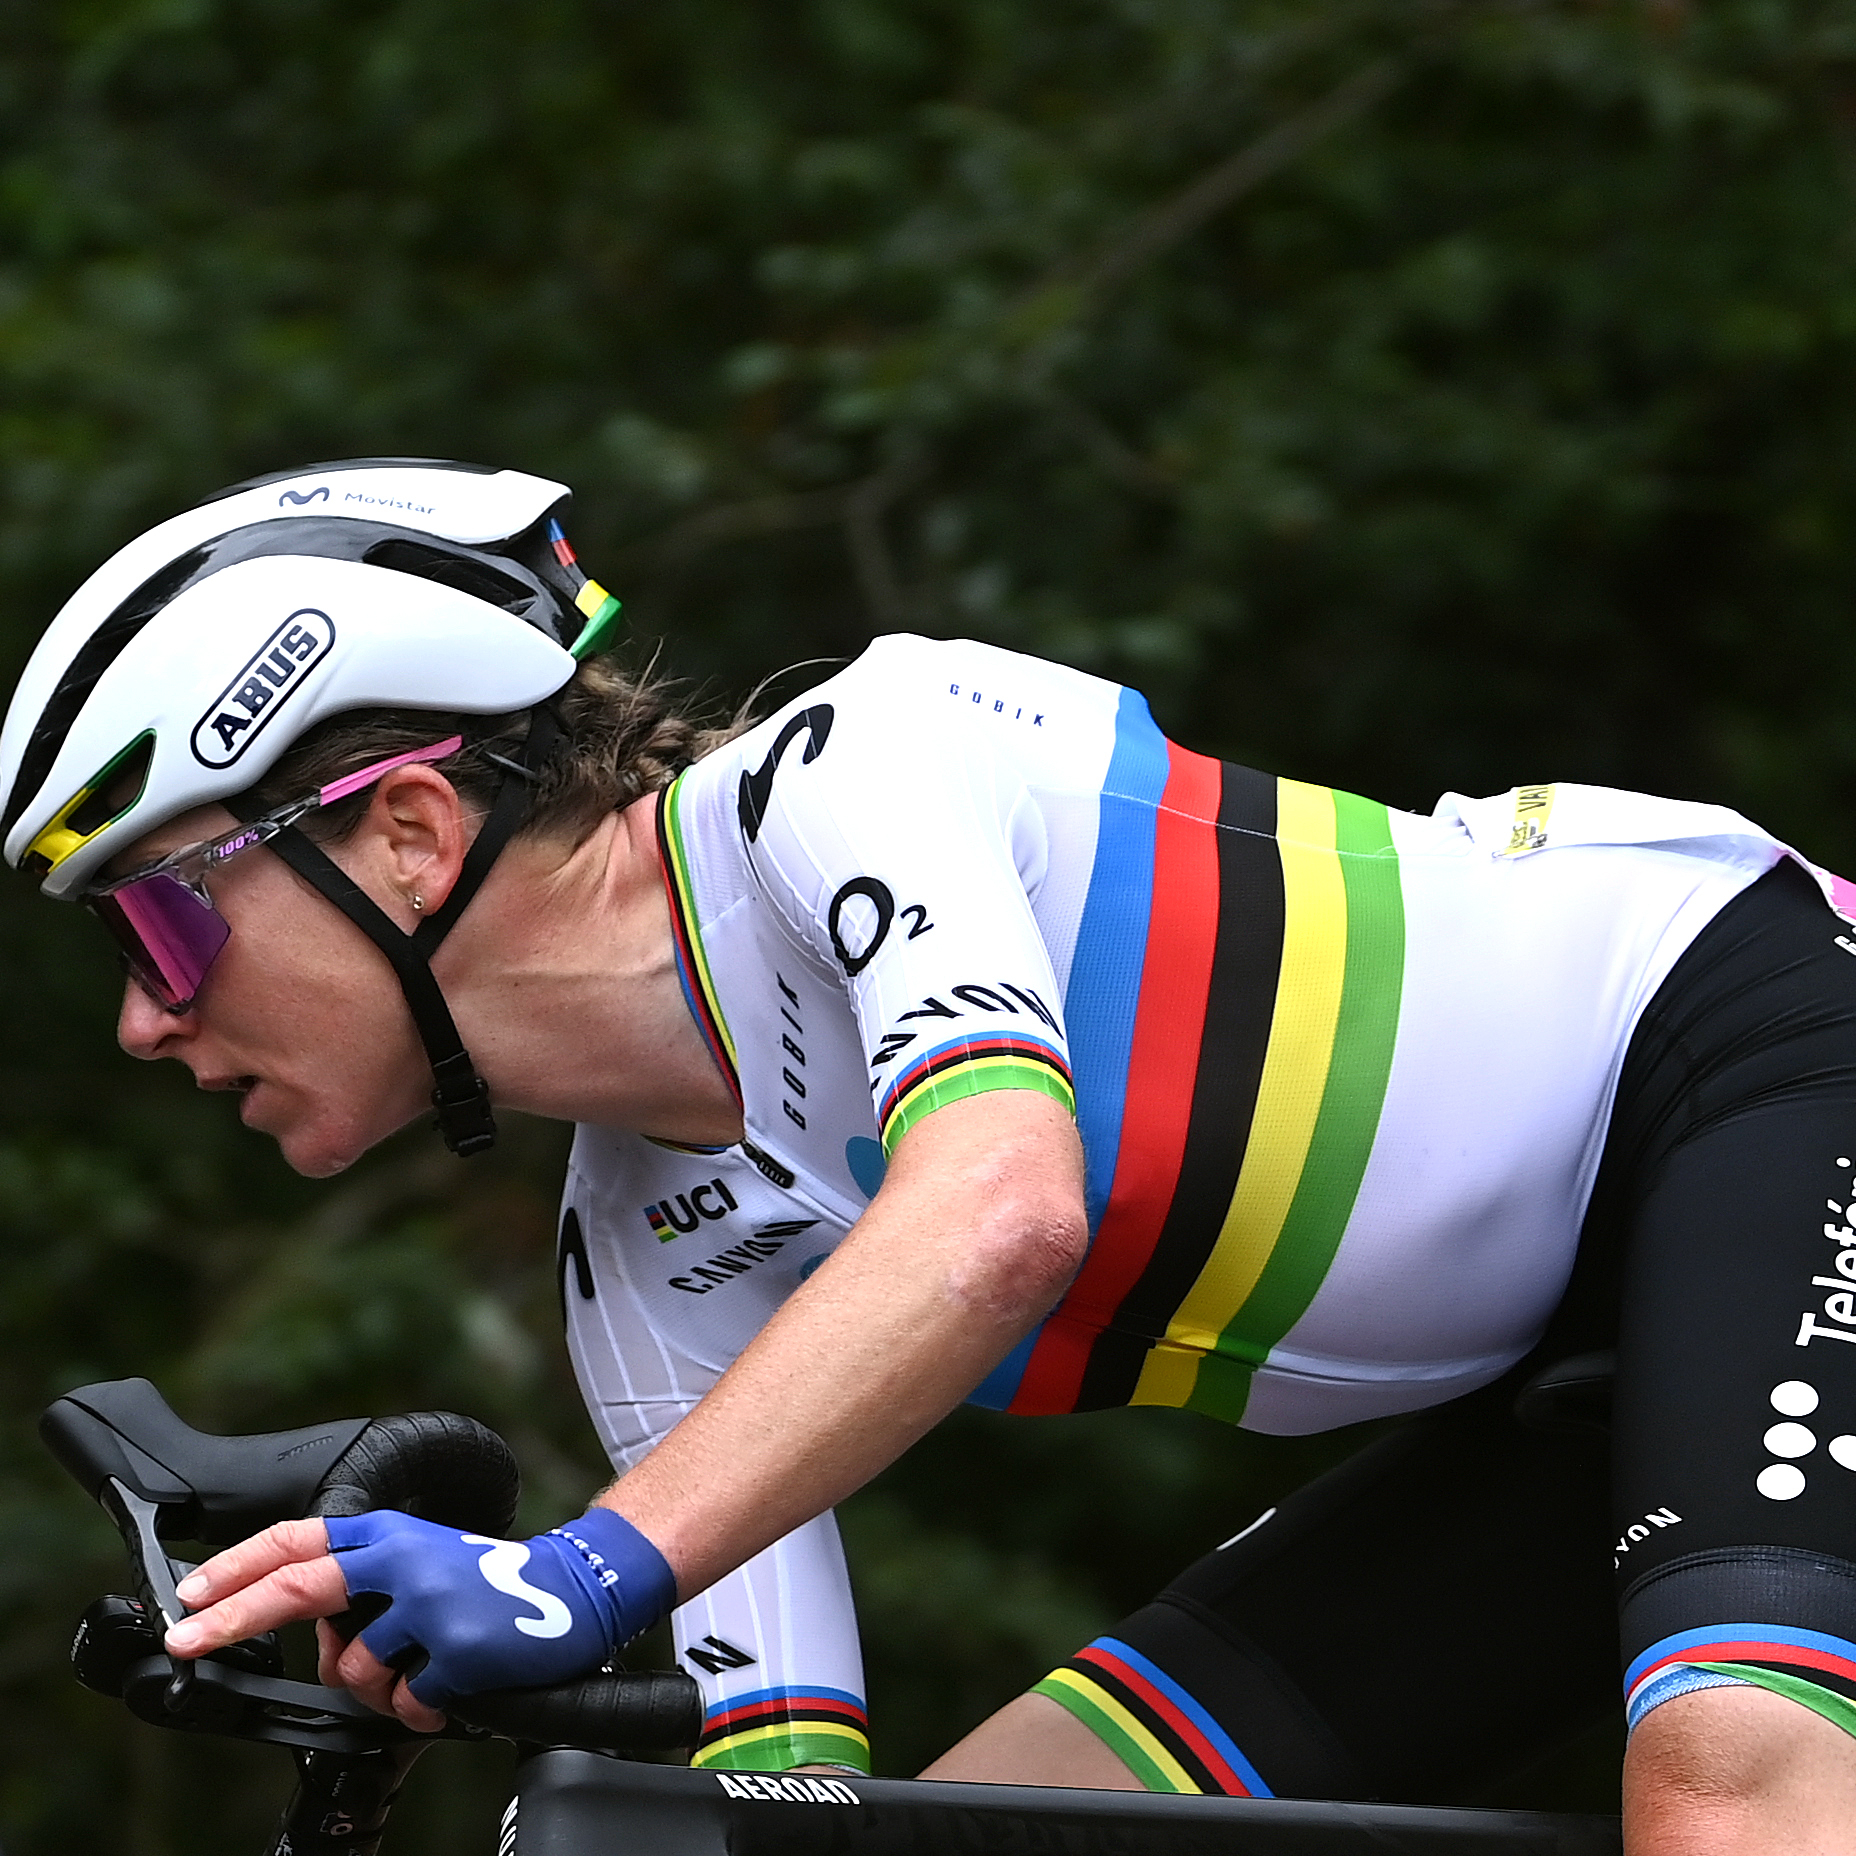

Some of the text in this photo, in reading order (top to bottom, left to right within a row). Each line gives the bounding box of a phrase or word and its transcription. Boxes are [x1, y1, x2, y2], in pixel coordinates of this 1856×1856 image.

[344, 489, 437, 517] Movistar
[209, 624, 320, 753] ABUS
[948, 682, 1047, 729] GOBIK
[216, 829, 261, 859] 100%
[774, 970, 807, 1131] GOBIK
[870, 981, 1065, 1094] NYON
[666, 1178, 739, 1235] UCI
[668, 1217, 822, 1295] CANYON
[715, 1773, 861, 1806] AEROAD
